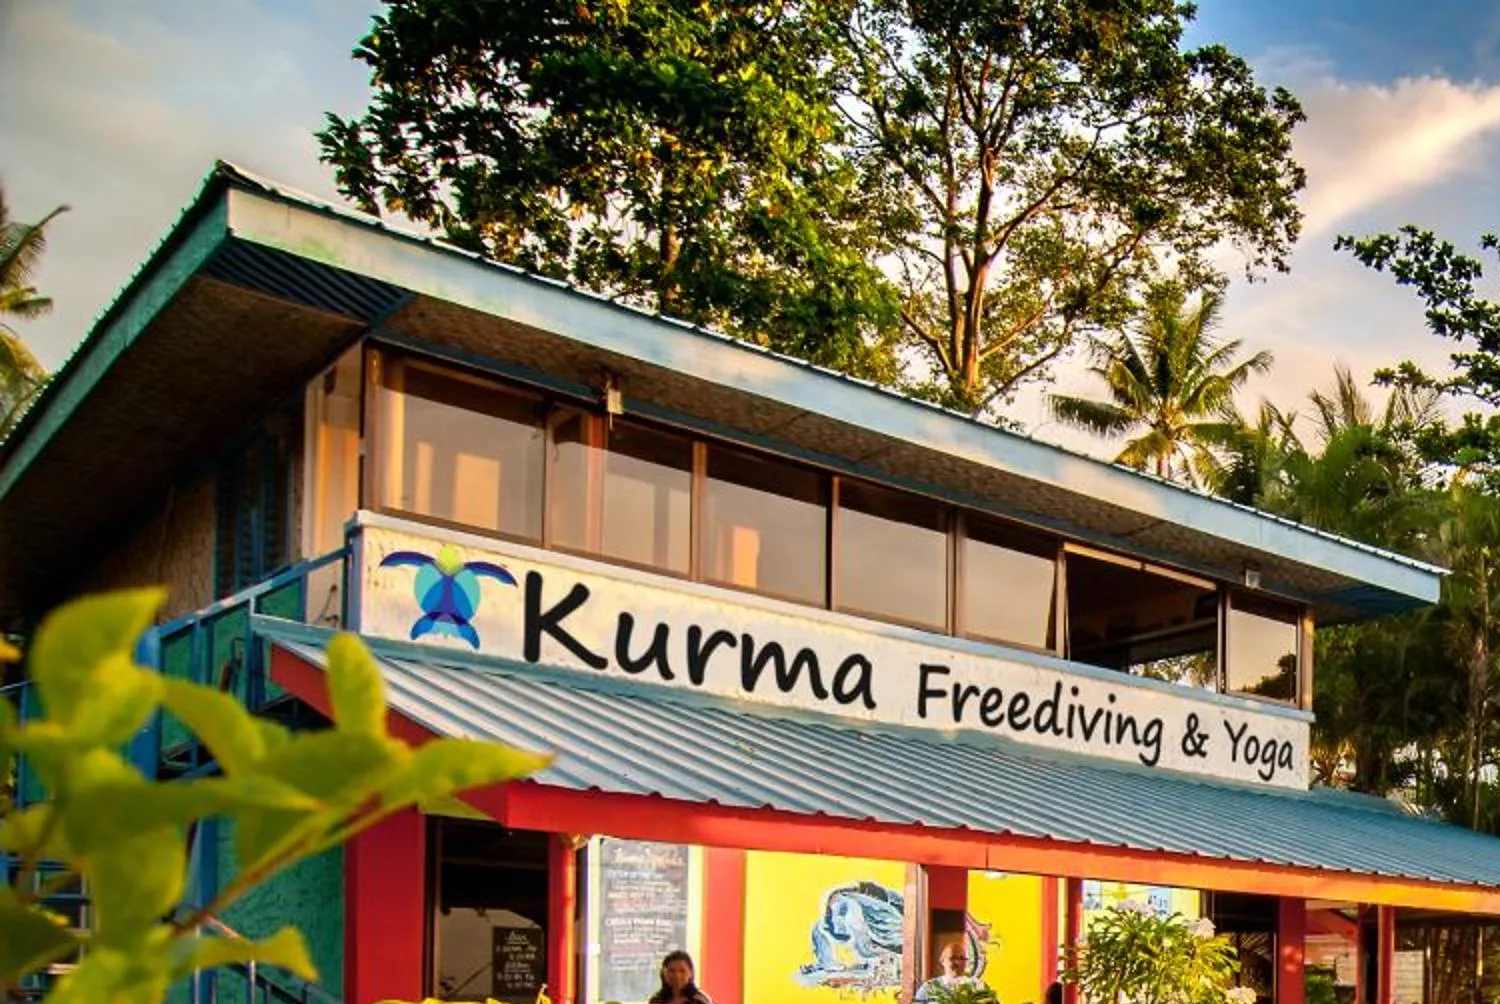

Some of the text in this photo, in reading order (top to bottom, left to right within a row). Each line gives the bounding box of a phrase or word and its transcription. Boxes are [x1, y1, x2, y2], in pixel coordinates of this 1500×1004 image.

[523, 570, 1294, 782] Kurma Freediving & Yoga
